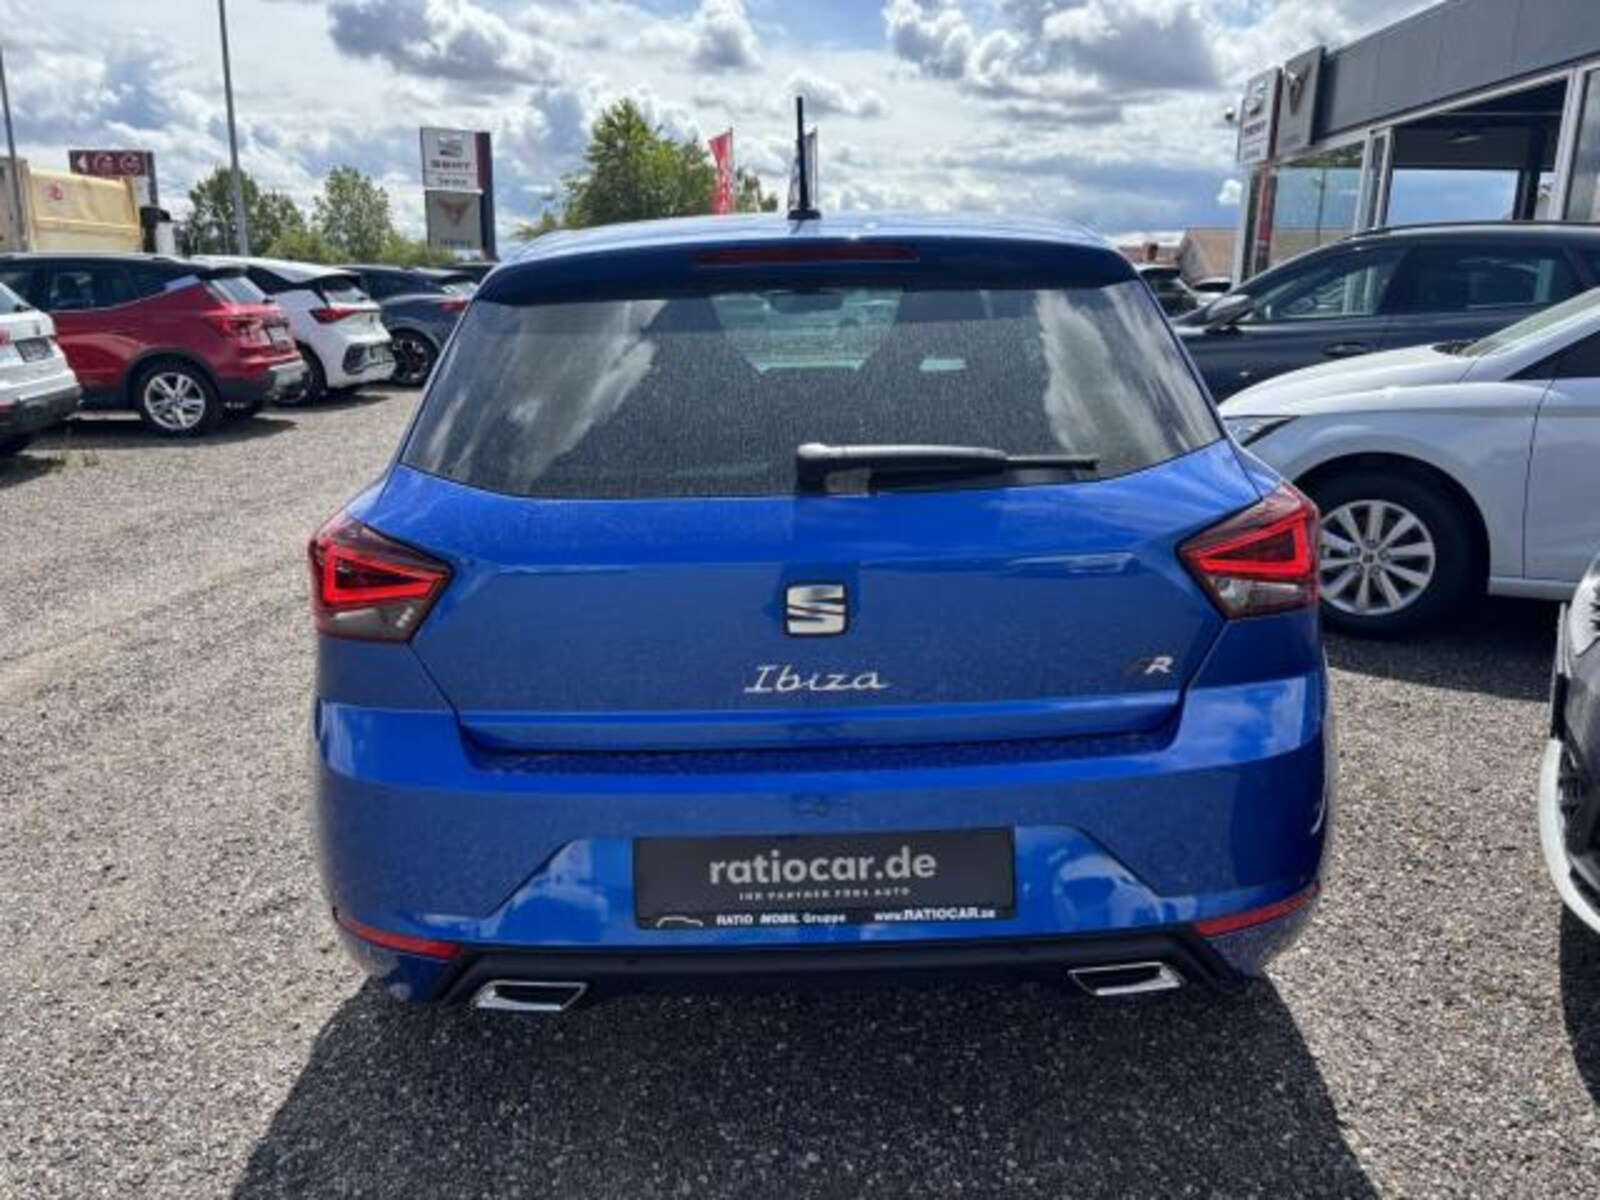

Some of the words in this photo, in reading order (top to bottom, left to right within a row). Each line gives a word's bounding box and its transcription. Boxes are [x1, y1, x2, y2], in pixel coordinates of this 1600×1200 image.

[744, 664, 894, 693] Ibiza
[708, 845, 938, 885] ratiocar.de
[716, 914, 754, 926] RATIO
[802, 912, 847, 925] Gruppe
